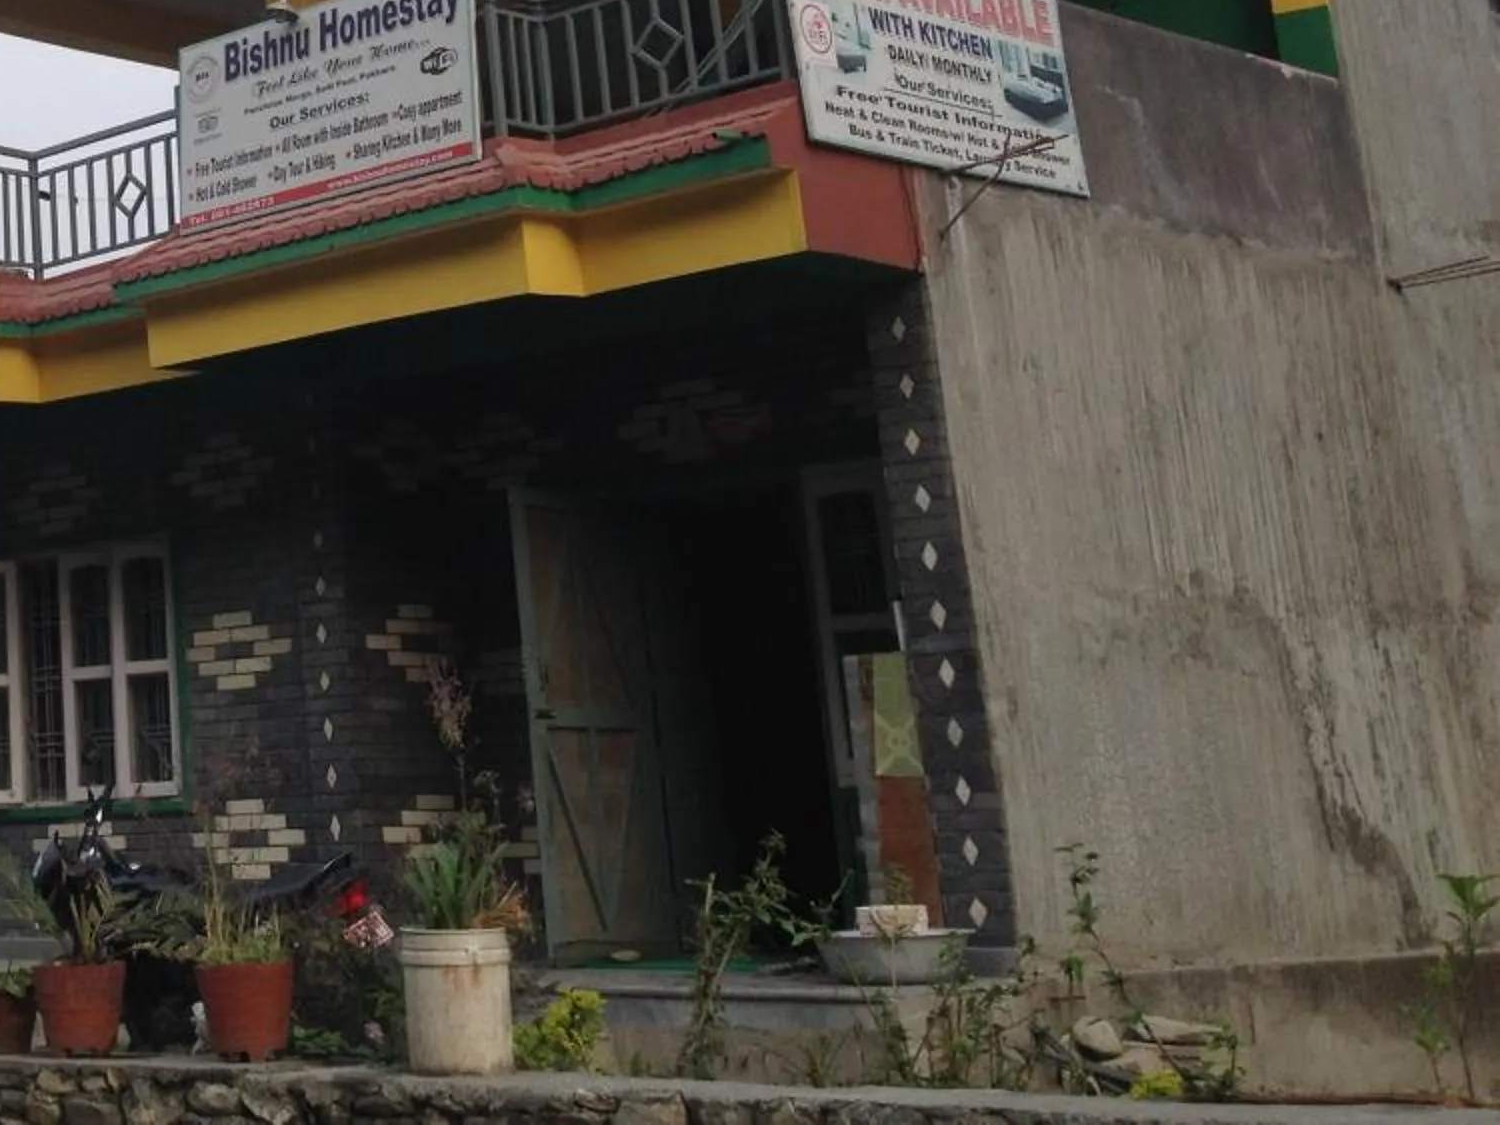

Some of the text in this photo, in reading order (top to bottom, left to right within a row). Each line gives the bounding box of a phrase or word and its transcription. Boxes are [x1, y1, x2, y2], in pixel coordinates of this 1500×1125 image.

[868, 6, 993, 60] WITH KITCHEN
[225, 27, 310, 82] Bishnu
[255, 75, 284, 97] Feel
[286, 65, 318, 85] Like
[269, 115, 295, 129] Our
[299, 92, 370, 121] Services:
[825, 101, 855, 119] Neat
[859, 108, 868, 121] &
[871, 110, 905, 128] Clean
[836, 85, 880, 104] Free
[884, 96, 949, 120] Tourist
[849, 123, 873, 140] Bus
[876, 130, 885, 142] &
[888, 132, 921, 150] Train
[1014, 160, 1057, 179] Service
